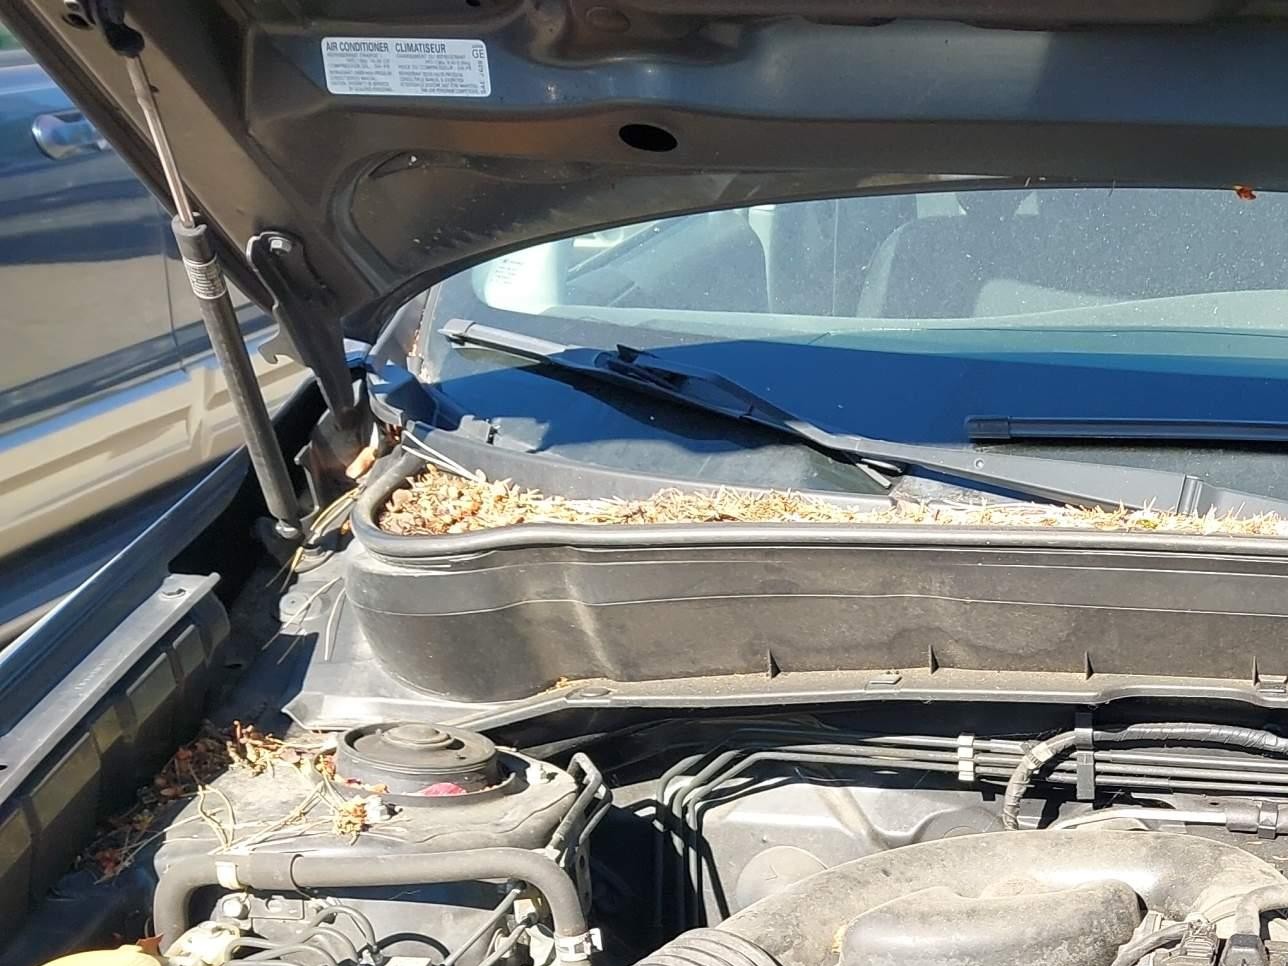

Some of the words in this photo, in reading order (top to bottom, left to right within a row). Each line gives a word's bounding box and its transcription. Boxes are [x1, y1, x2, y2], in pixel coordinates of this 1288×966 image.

[326, 41, 338, 51] AIR
[339, 41, 389, 52] CONDITIONER
[395, 42, 447, 53] CLIMATISEUR
[471, 49, 485, 59] GE
